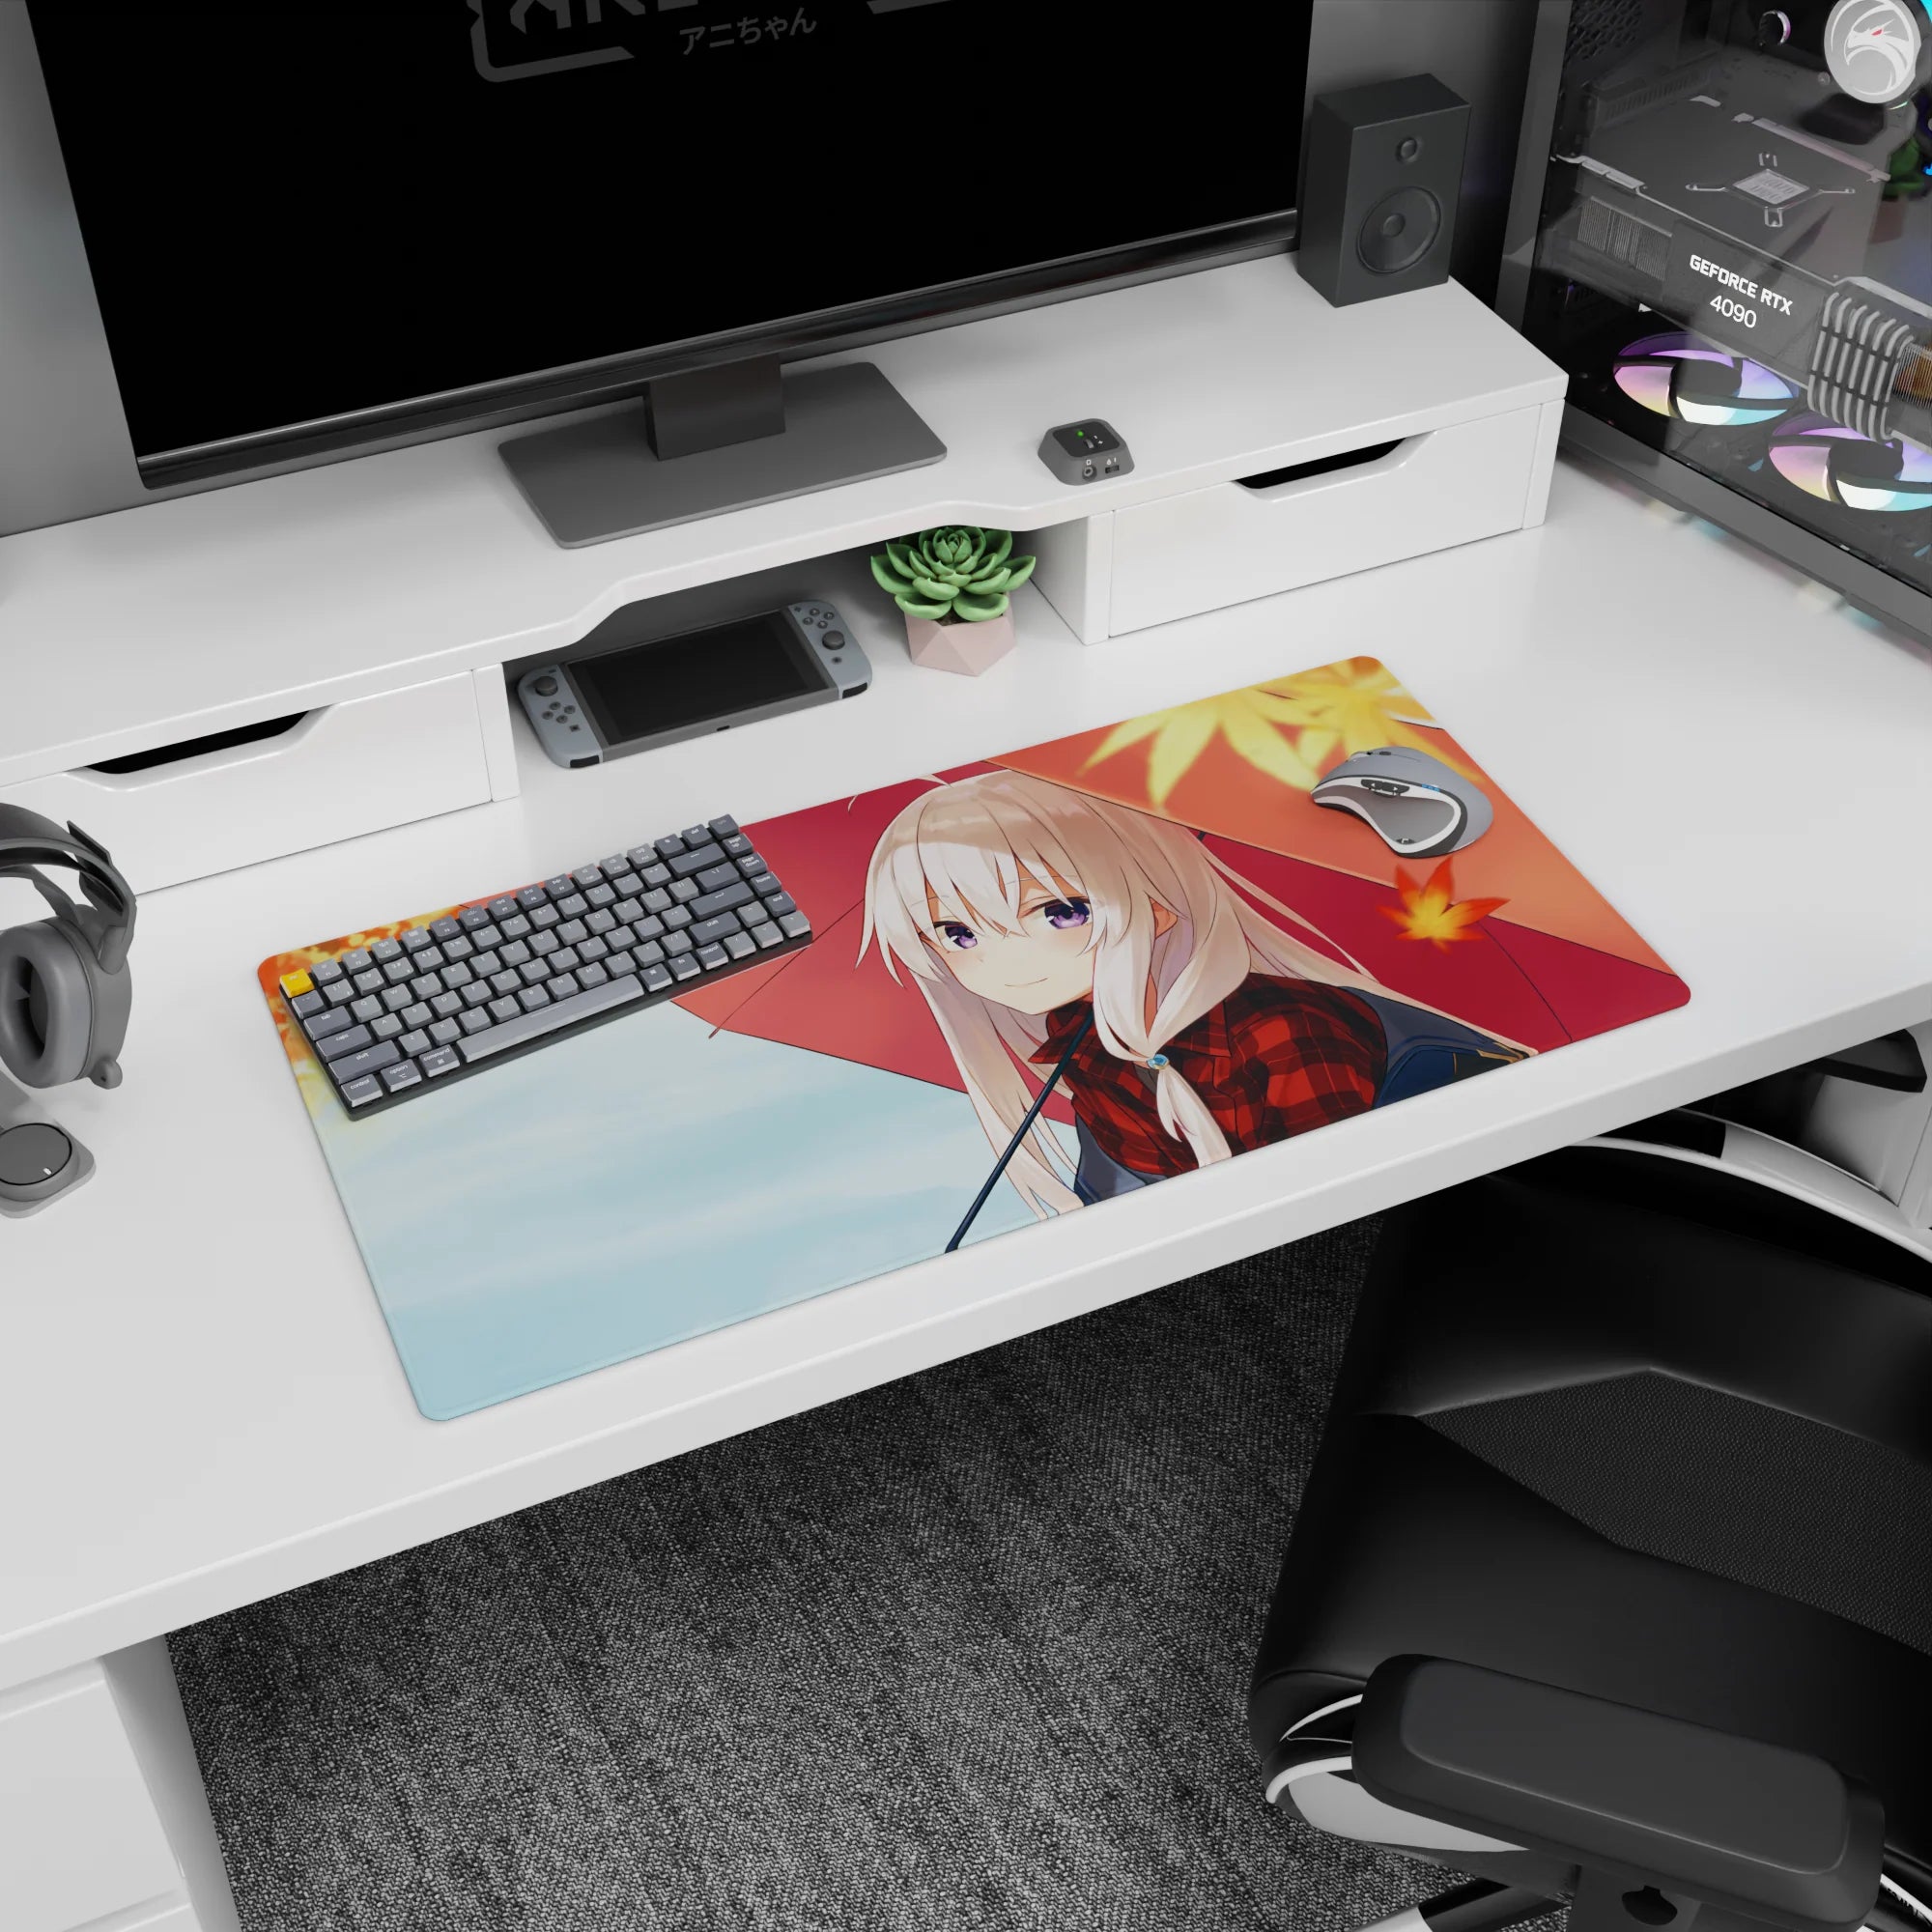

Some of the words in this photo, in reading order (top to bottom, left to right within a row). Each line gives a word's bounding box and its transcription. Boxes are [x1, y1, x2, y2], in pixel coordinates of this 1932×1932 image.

[680, 8, 817, 55] アニちゃん
[1690, 254, 1758, 298] GEFORCE
[1760, 288, 1793, 315] RTX
[1710, 296, 1756, 328] 4090
[701, 946, 719, 954] control
[423, 1048, 449, 1061] command
[389, 1065, 408, 1074] option
[351, 1078, 370, 1089] control
